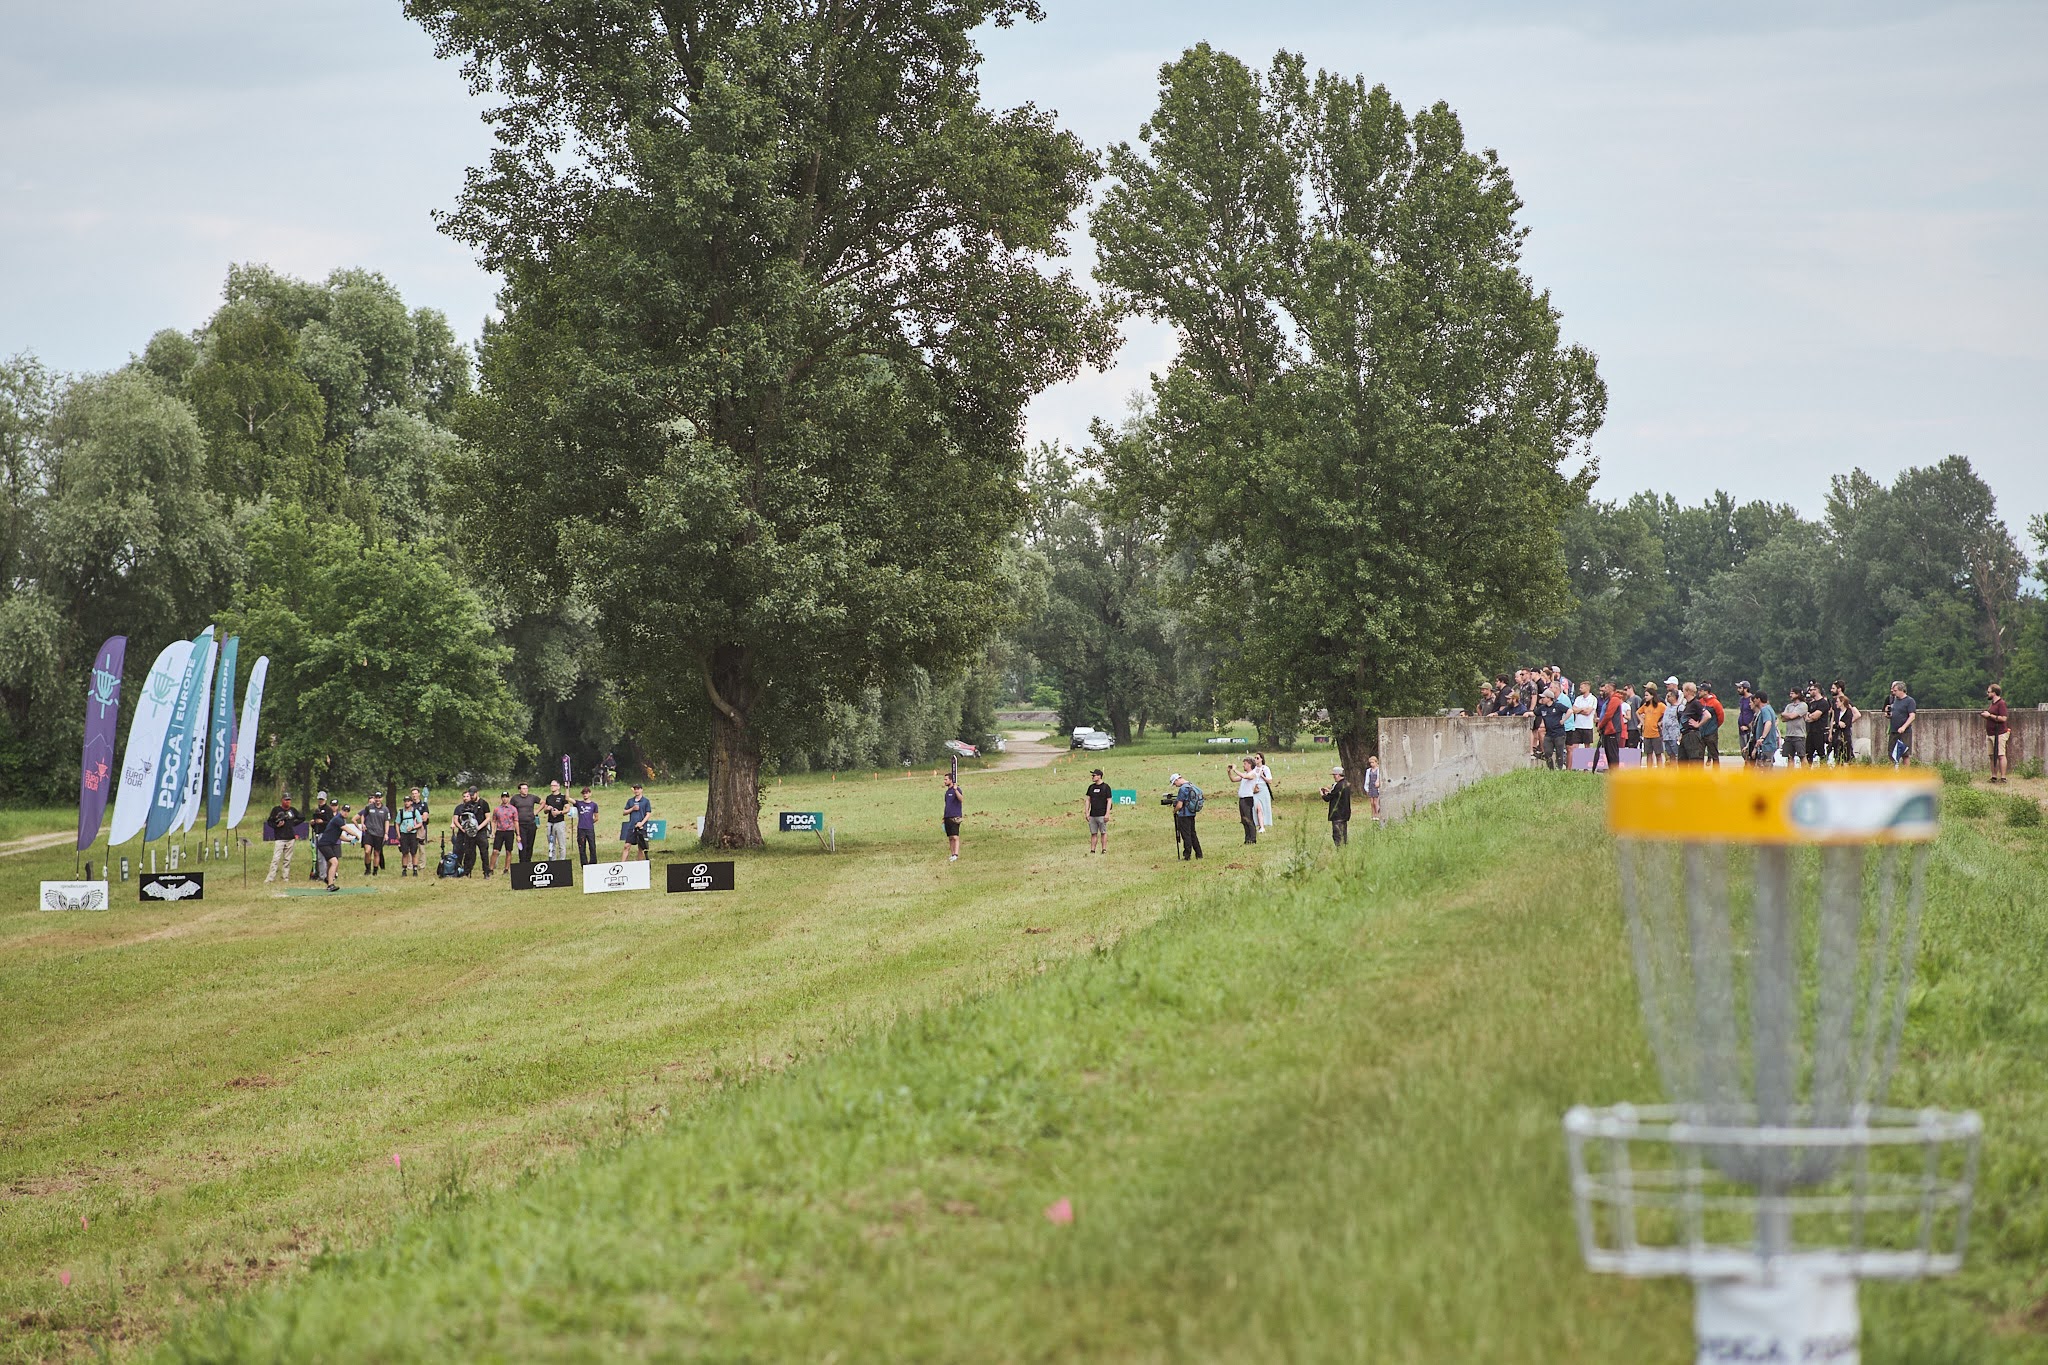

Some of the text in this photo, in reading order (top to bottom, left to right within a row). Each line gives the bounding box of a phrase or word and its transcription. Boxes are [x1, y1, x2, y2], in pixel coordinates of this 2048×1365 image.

[213, 658, 230, 796] PDGA EUROPE
[157, 733, 184, 809] PDGA
[176, 658, 196, 721] EUROPE
[85, 773, 99, 784] EURO
[126, 769, 144, 781] EURO
[85, 781, 99, 792] TOUR
[125, 776, 143, 788] TOUR
[786, 815, 816, 824] PDGA
